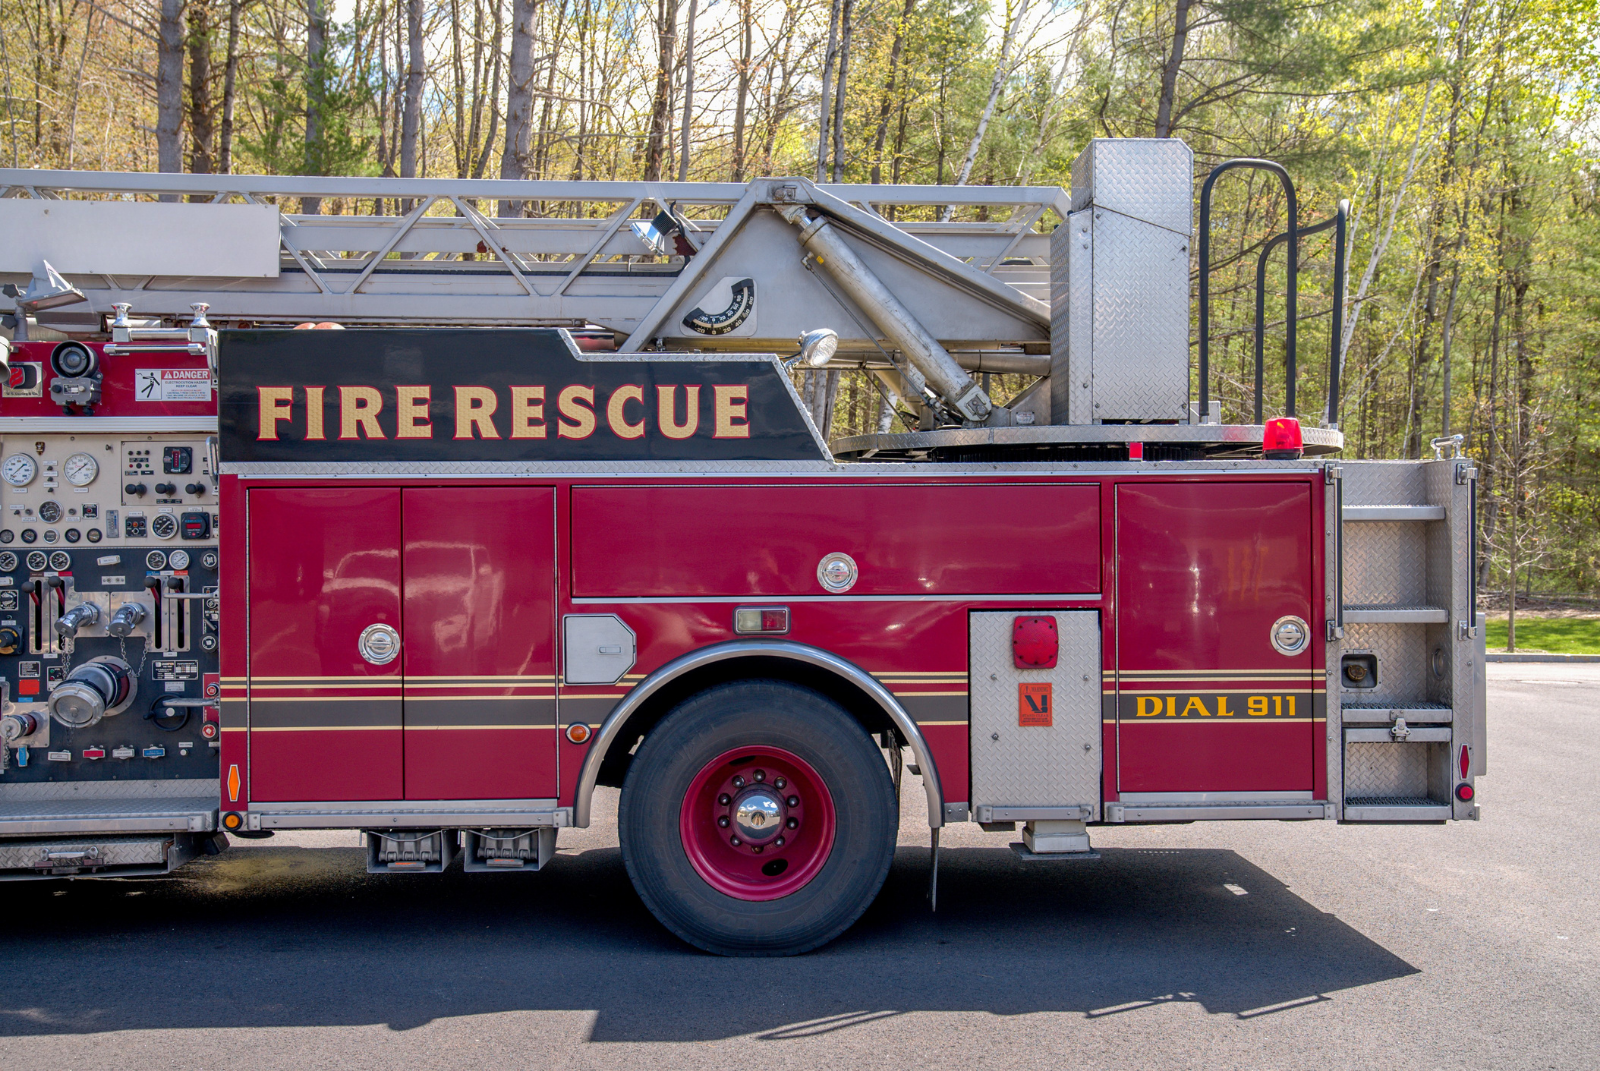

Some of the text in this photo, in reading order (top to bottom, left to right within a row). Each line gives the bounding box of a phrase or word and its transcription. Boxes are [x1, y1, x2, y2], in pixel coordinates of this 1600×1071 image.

[735, 319, 743, 327] 40
[173, 370, 208, 379] DANGER
[255, 383, 751, 441] FIRE RESCUE
[1136, 695, 1296, 717] DIAL 911
